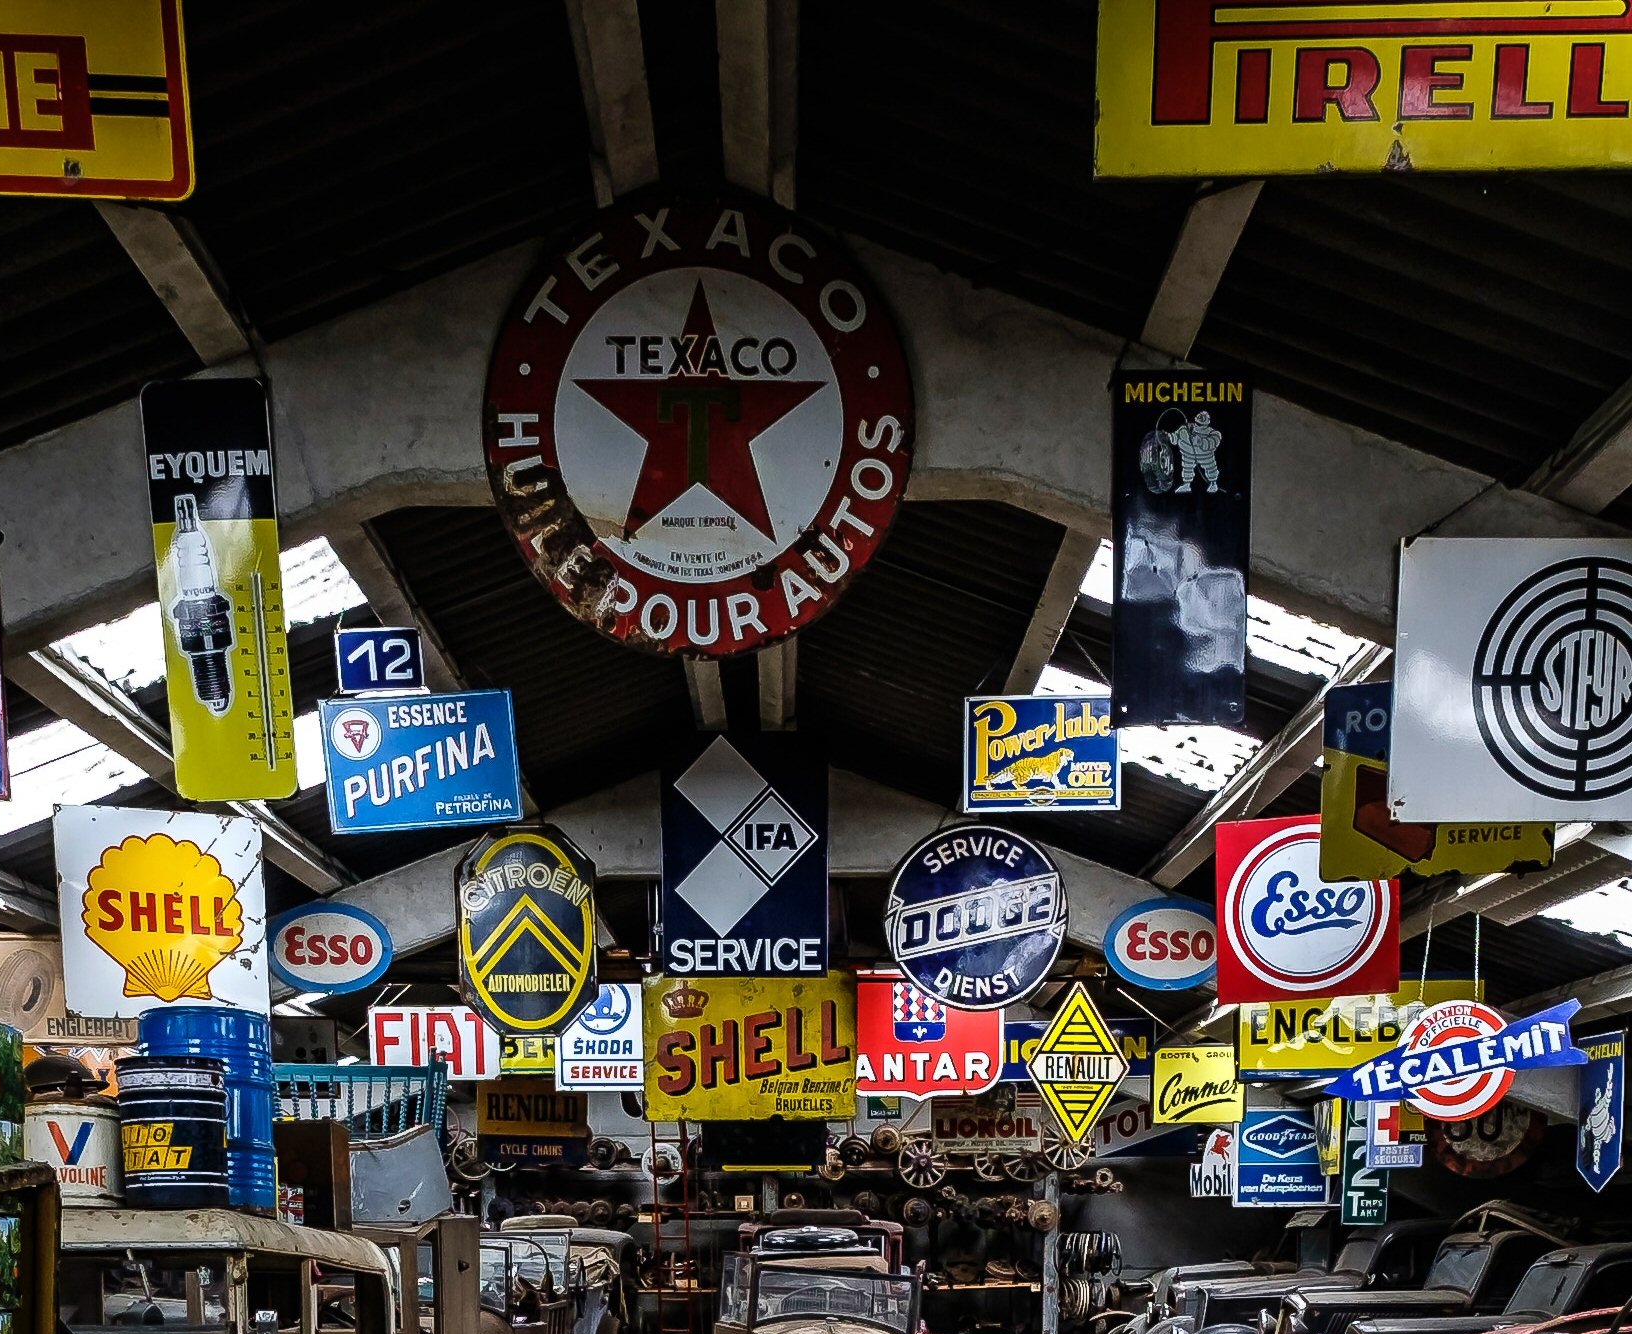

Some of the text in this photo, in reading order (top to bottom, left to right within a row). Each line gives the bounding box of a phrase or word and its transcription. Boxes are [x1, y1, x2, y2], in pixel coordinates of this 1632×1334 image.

[522, 208, 868, 333] TEXACO
[605, 335, 798, 377] TEXACO
[1125, 382, 1244, 404] MICHELIN
[149, 449, 270, 482] EYQUEM
[779, 415, 905, 617] AUTOS
[347, 639, 414, 681] 12
[388, 701, 467, 729] ESSENCE
[343, 723, 496, 819] PURFINA
[1067, 771, 1112, 787] OIL
[435, 798, 513, 816] PETROFINA
[744, 822, 798, 851] IFA
[1448, 825, 1522, 845] SERVICE
[923, 836, 1023, 875] SERVICE
[97, 889, 235, 937] SHELL
[901, 881, 1053, 952] DODGE
[669, 938, 822, 973] SERVICE
[487, 973, 572, 993] AUTOMOBIELEN
[934, 966, 1023, 999] DIENST
[46, 1017, 131, 1037] ENGLEBERT
[1250, 1006, 1425, 1046] ENGLEB
[1422, 1004, 1475, 1028] STATION
[374, 1011, 486, 1076] FIAT
[573, 1036, 633, 1056] ŠKODA
[1419, 1017, 1484, 1047] OFFICIELLE
[656, 1000, 852, 1098] SHELL
[1353, 1020, 1566, 1096] TÉCALÉMIT
[570, 1065, 638, 1079] SERVICE
[856, 1052, 991, 1081] ANTAR
[1045, 1056, 1113, 1080] RENAULT
[760, 1078, 800, 1097] Belgian
[802, 1077, 841, 1094] Benzine
[487, 1093, 578, 1122] RENOLD
[775, 1097, 833, 1112] BRUXELLES
[500, 1143, 563, 1156] CYCLE CHAINS
[1379, 1146, 1410, 1155] POSTE
[1192, 1165, 1234, 1197] Mobil
